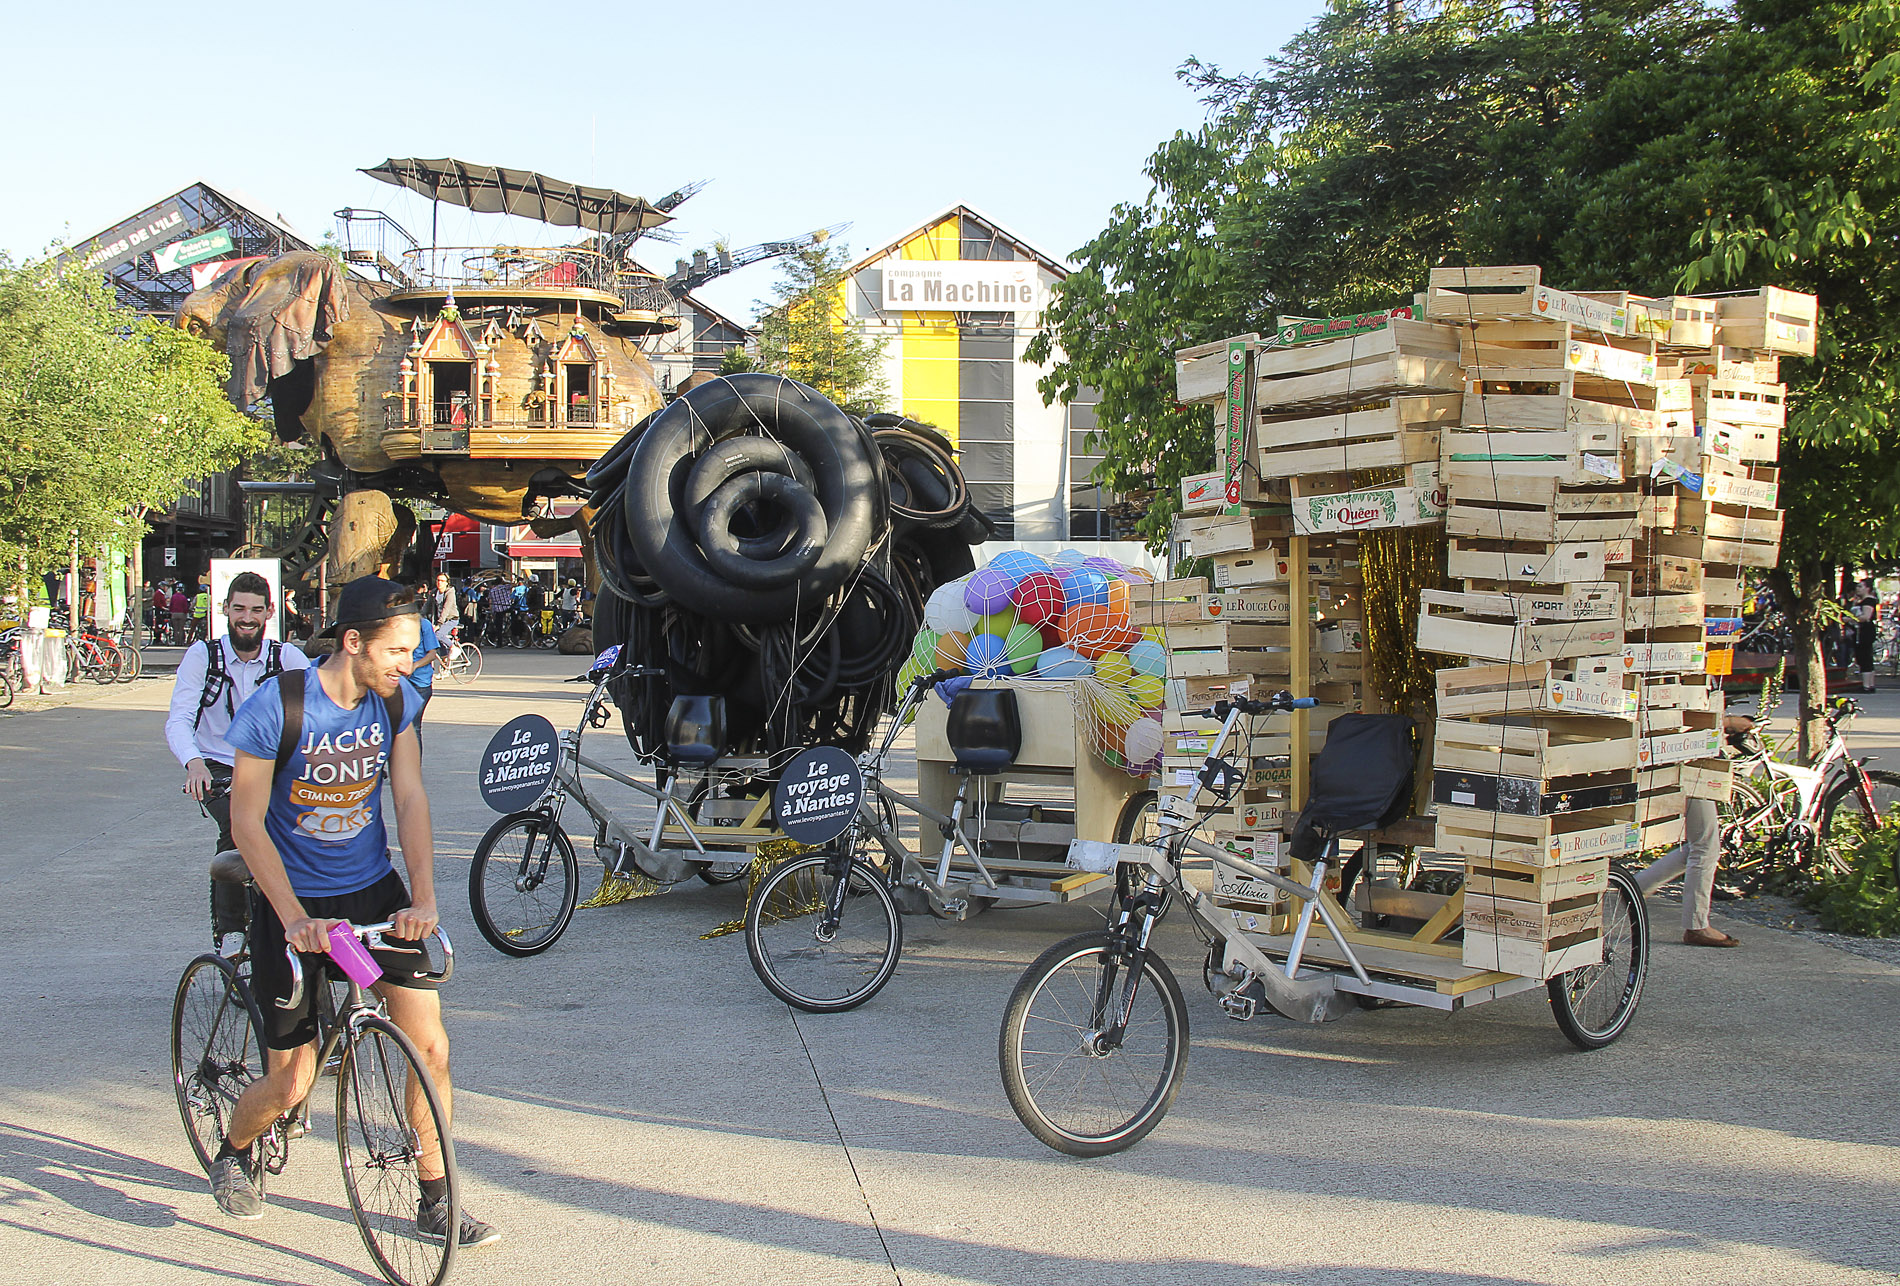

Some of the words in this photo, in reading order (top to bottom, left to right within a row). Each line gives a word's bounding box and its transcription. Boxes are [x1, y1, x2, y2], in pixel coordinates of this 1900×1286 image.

[82, 239, 130, 271] HINES
[127, 227, 150, 247] DE
[888, 270, 943, 278] compagnie
[888, 279, 914, 302] La
[923, 280, 1033, 303] Machine
[1301, 323, 1325, 337] Miam
[1327, 319, 1352, 333] Miam
[1353, 313, 1388, 329] Sologne
[1231, 370, 1243, 400] Miam
[1231, 404, 1243, 434] Miam
[1531, 601, 1564, 611] XPORT
[511, 728, 532, 746] Le
[492, 742, 550, 765] voyage
[298, 751, 386, 784] JONES
[483, 769, 495, 785] à
[494, 761, 552, 783] Nantes
[807, 761, 829, 778] Le
[1255, 768, 1292, 783] BIOGAR
[297, 789, 322, 802] CTM
[787, 773, 850, 797] voyage
[781, 801, 792, 817] à
[793, 792, 855, 815] Nantes
[787, 808, 850, 826] www.levoyageanantes.fr
